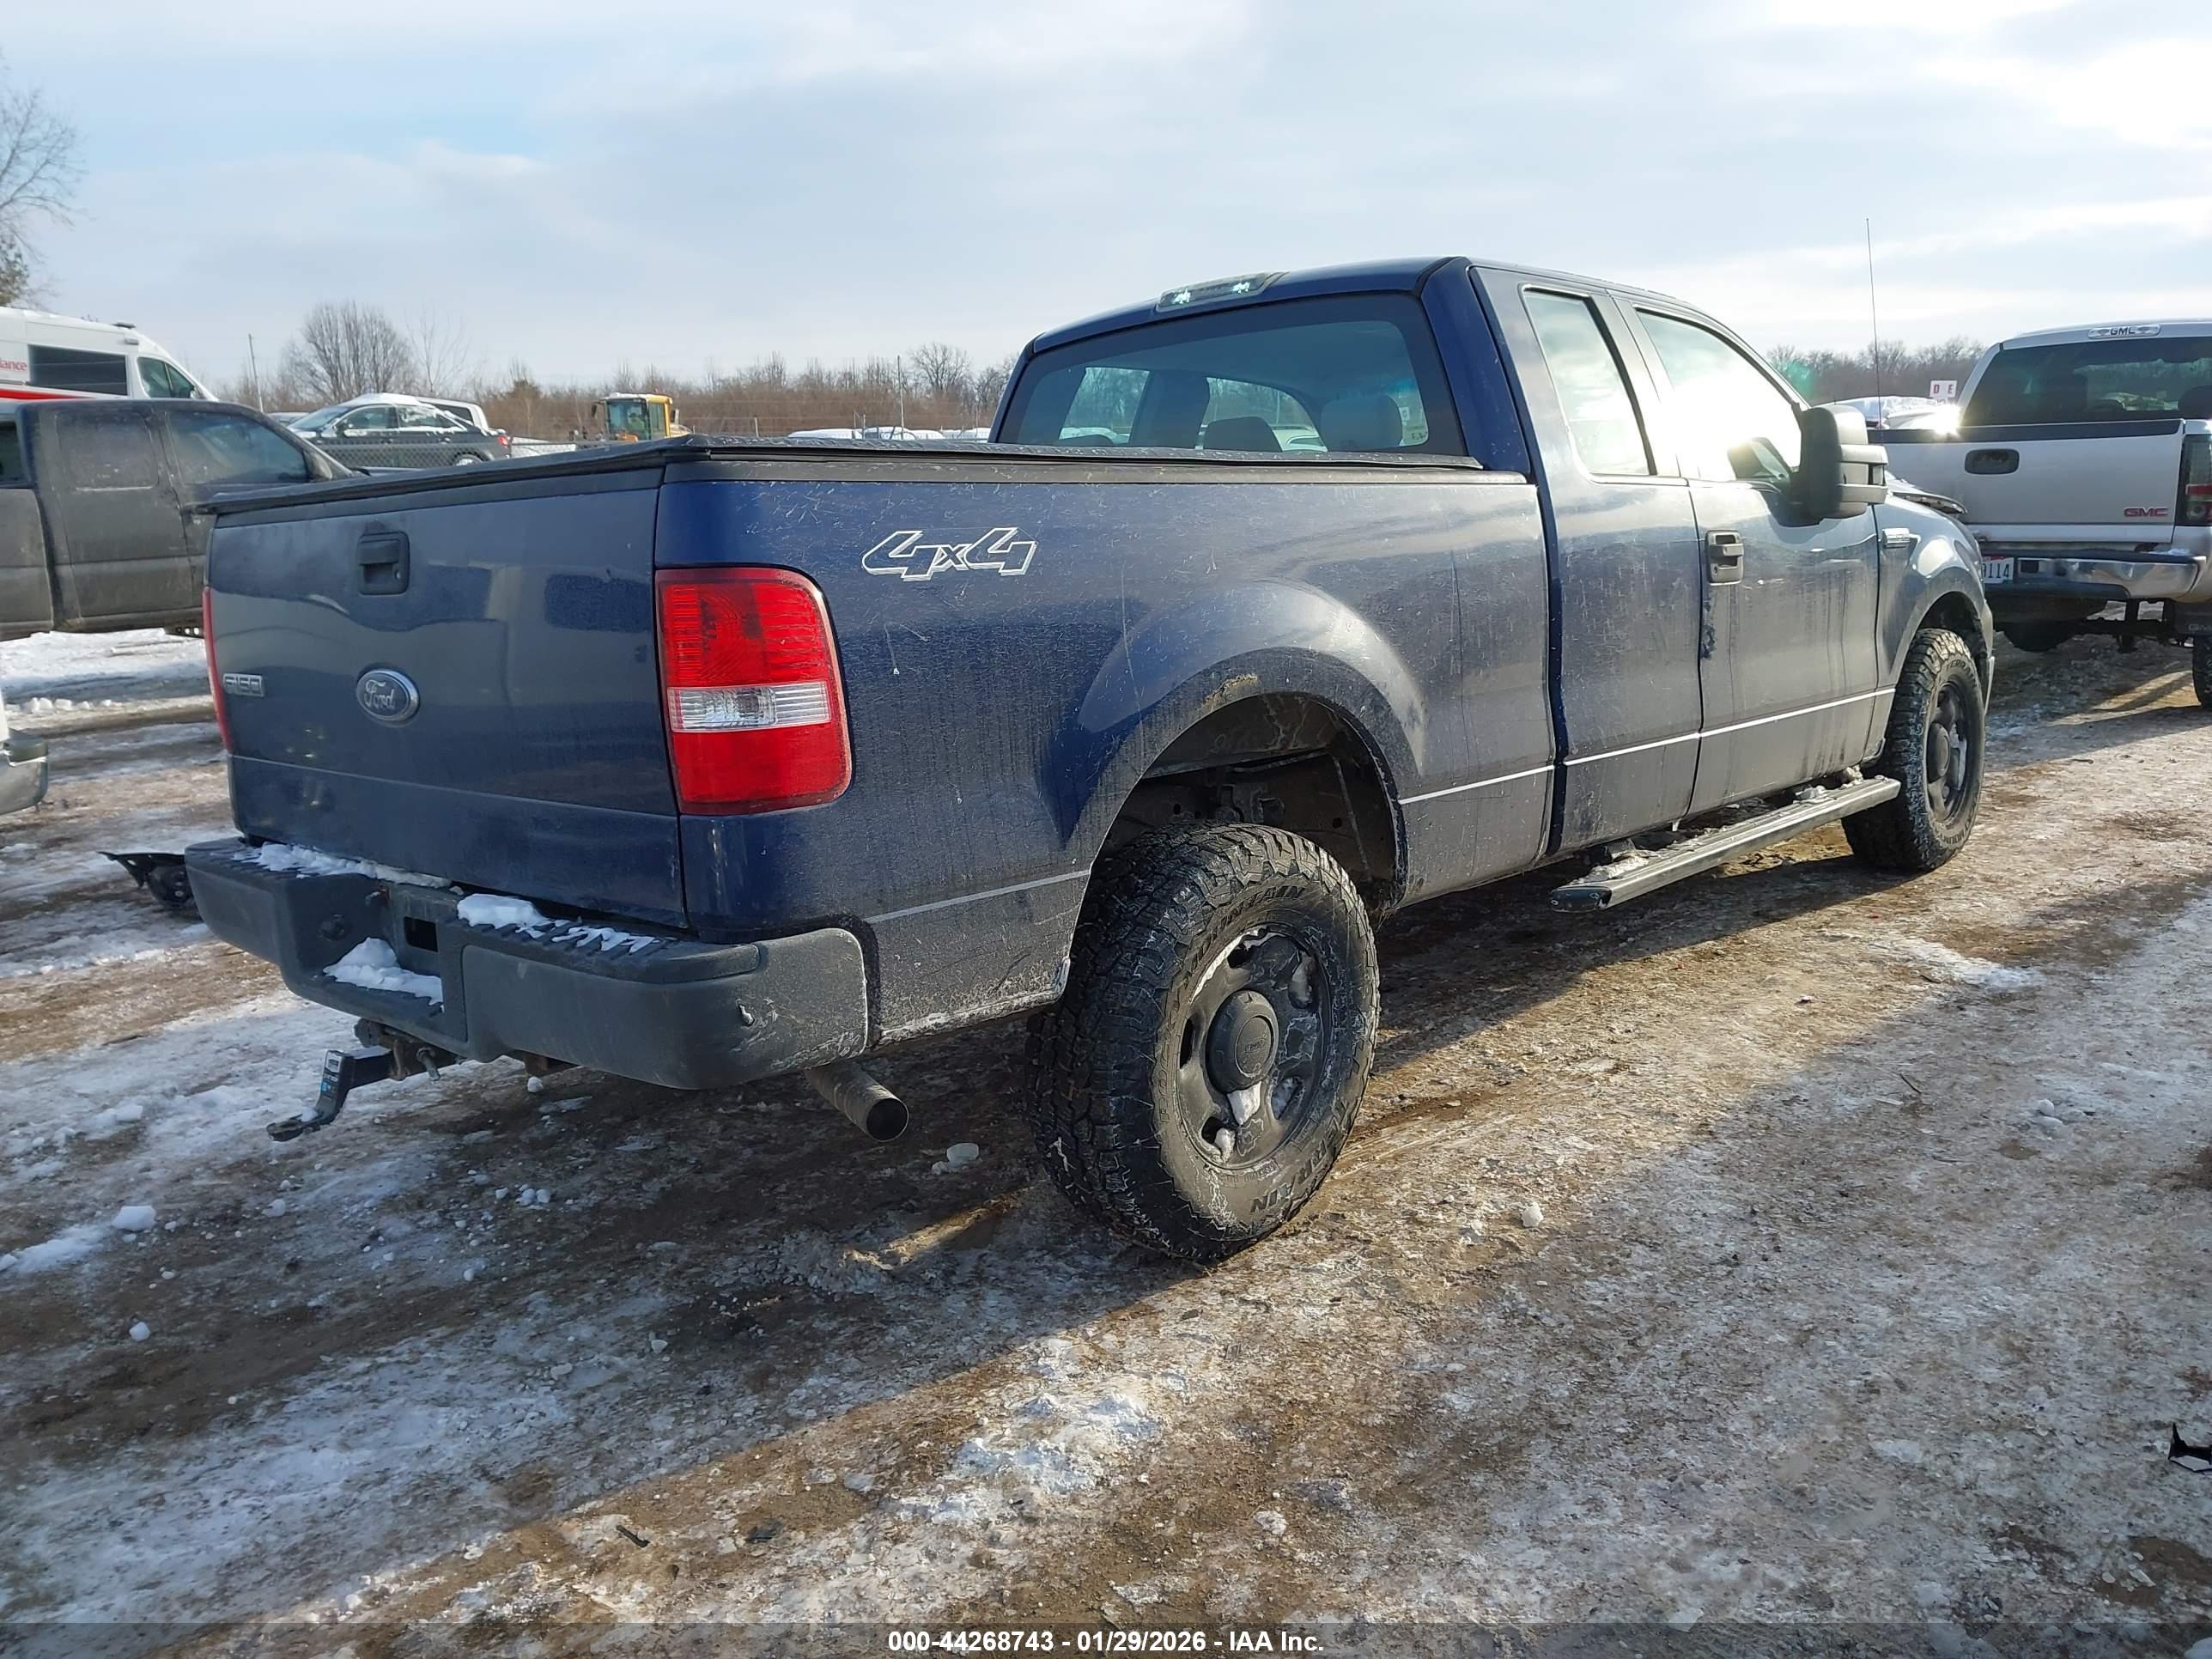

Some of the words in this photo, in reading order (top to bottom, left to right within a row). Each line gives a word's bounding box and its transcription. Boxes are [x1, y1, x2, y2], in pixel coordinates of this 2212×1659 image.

[2124, 507, 2168, 517] GMC
[862, 527, 1037, 581] 4x4
[364, 679, 396, 710] Ford
